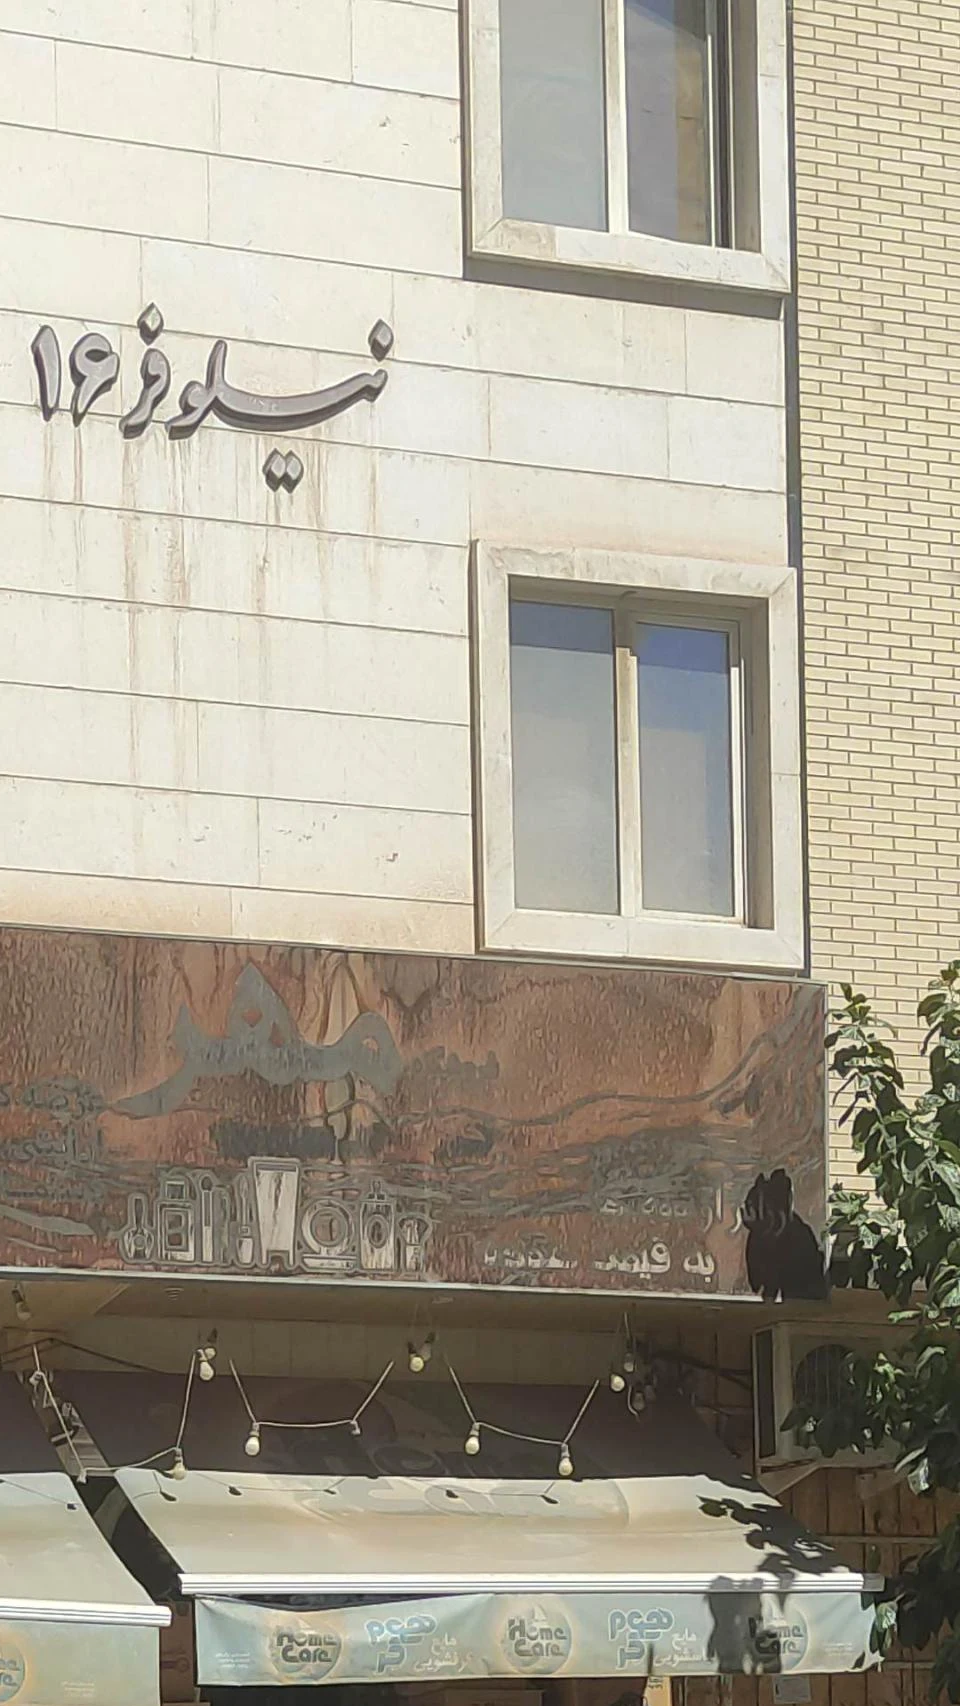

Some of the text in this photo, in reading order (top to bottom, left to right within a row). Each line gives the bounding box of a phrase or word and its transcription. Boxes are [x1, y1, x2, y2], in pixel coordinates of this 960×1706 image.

[30, 302, 394, 493] نیلوفر ۱۶
[508, 1617, 567, 1641] Home
[513, 1638, 565, 1657] Care
